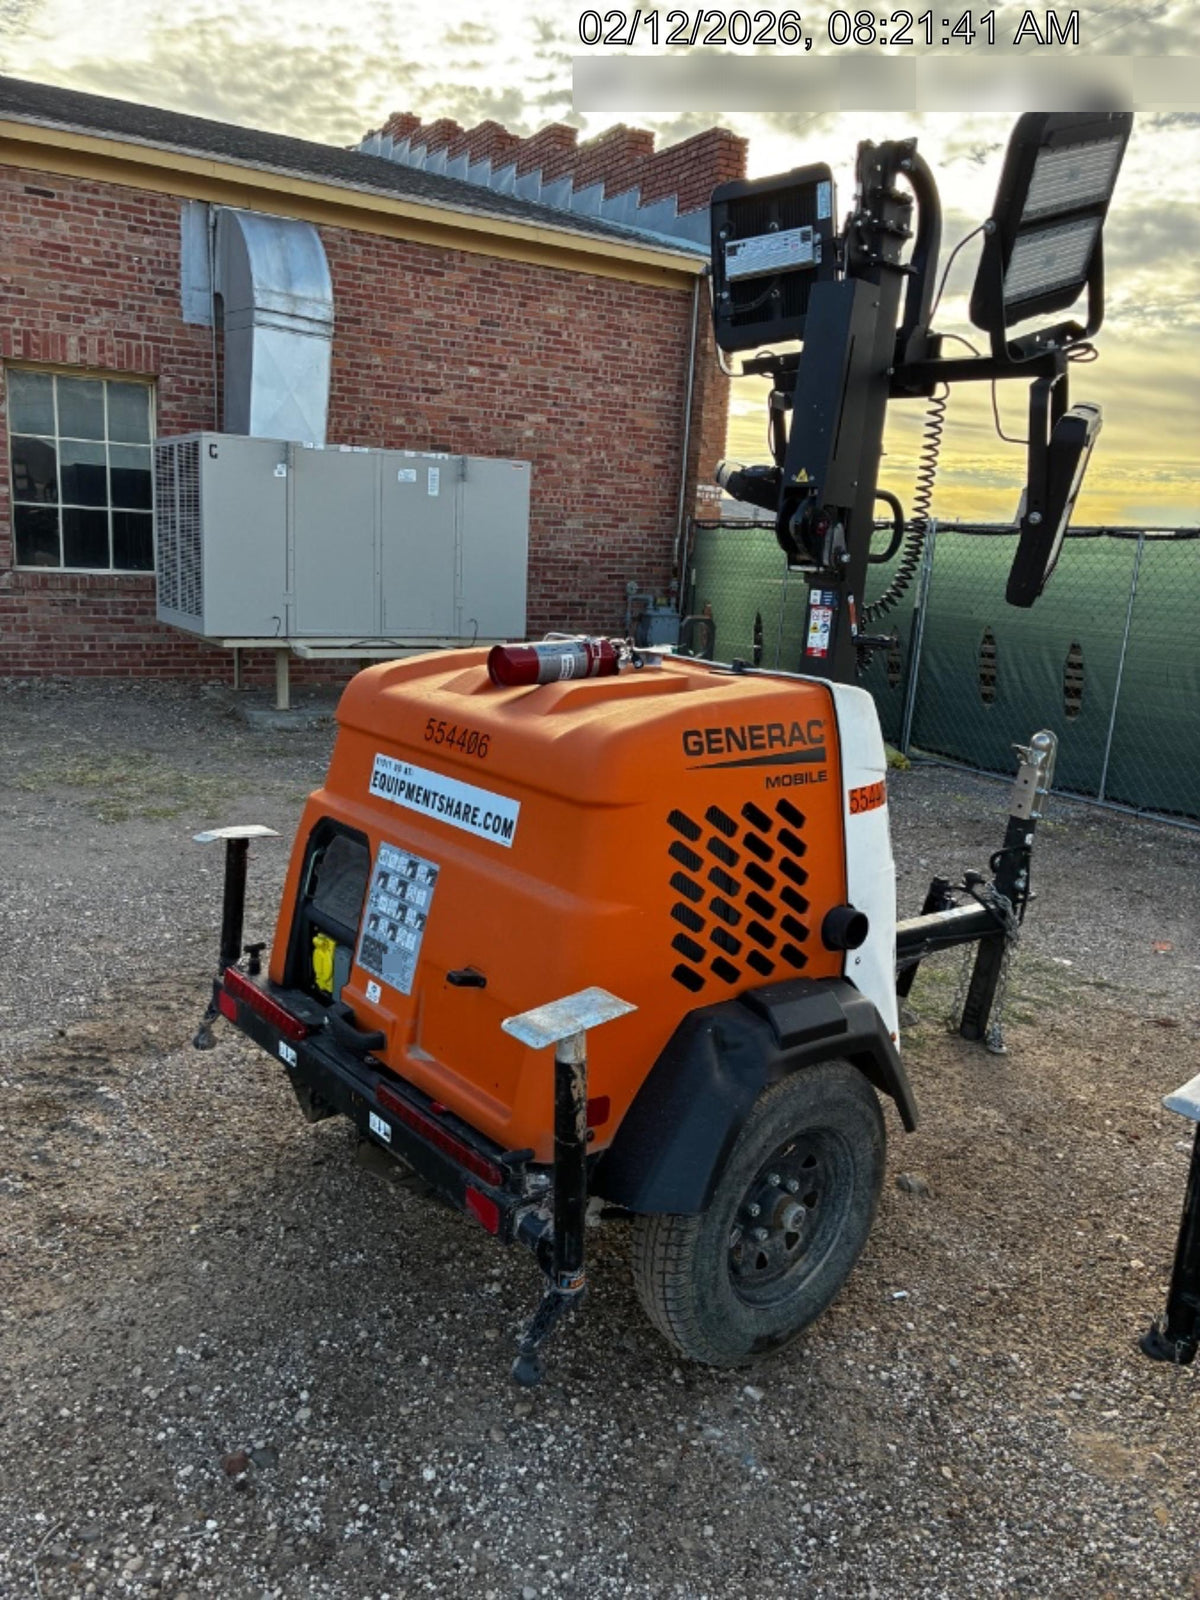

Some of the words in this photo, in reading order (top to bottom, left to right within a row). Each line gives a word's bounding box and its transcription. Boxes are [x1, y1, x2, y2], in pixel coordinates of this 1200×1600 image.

[424, 718, 490, 759] 554406
[682, 719, 826, 757] GENERAC
[765, 769, 829, 789] MOBILE
[371, 770, 515, 840] EQUIPMENTSHARE.COM
